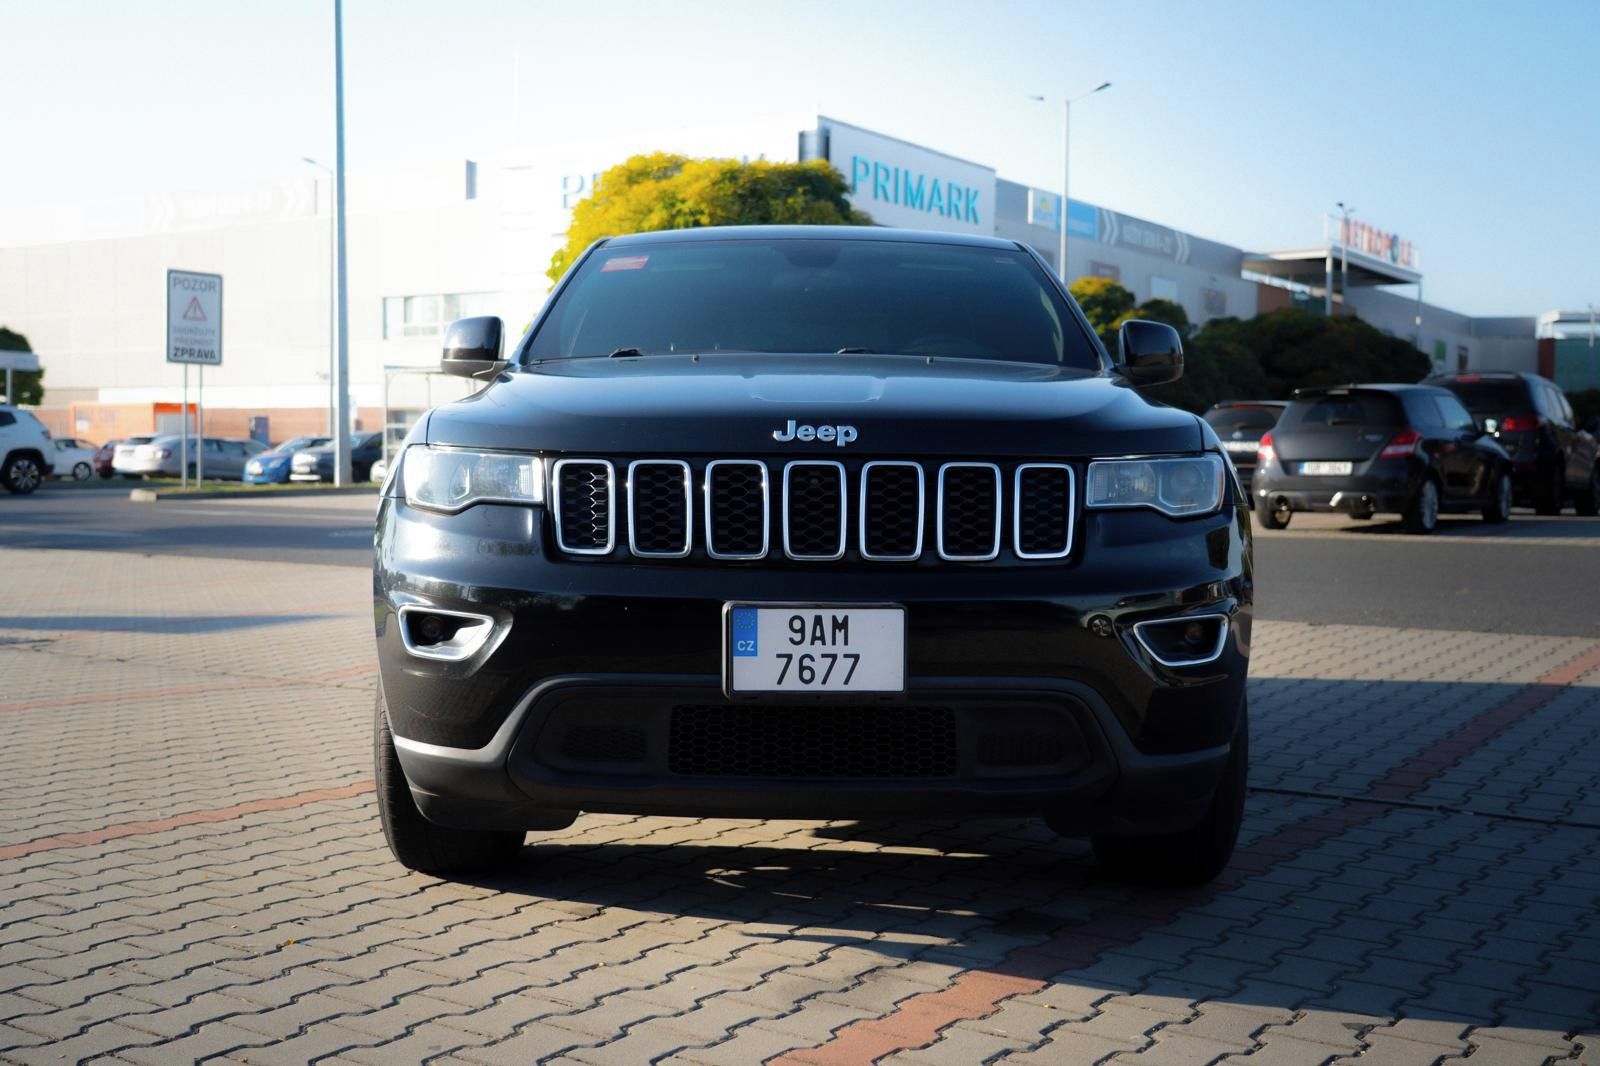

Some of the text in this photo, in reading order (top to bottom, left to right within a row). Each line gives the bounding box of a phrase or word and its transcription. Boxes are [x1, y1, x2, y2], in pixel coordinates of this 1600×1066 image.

[851, 155, 980, 225] PRIMARK
[173, 277, 217, 292] POZOR
[173, 346, 217, 360] ZPRAVA
[773, 419, 858, 447] Jeep
[788, 615, 849, 646] 9AM
[737, 640, 755, 652] CZ
[776, 653, 861, 685] 7677
